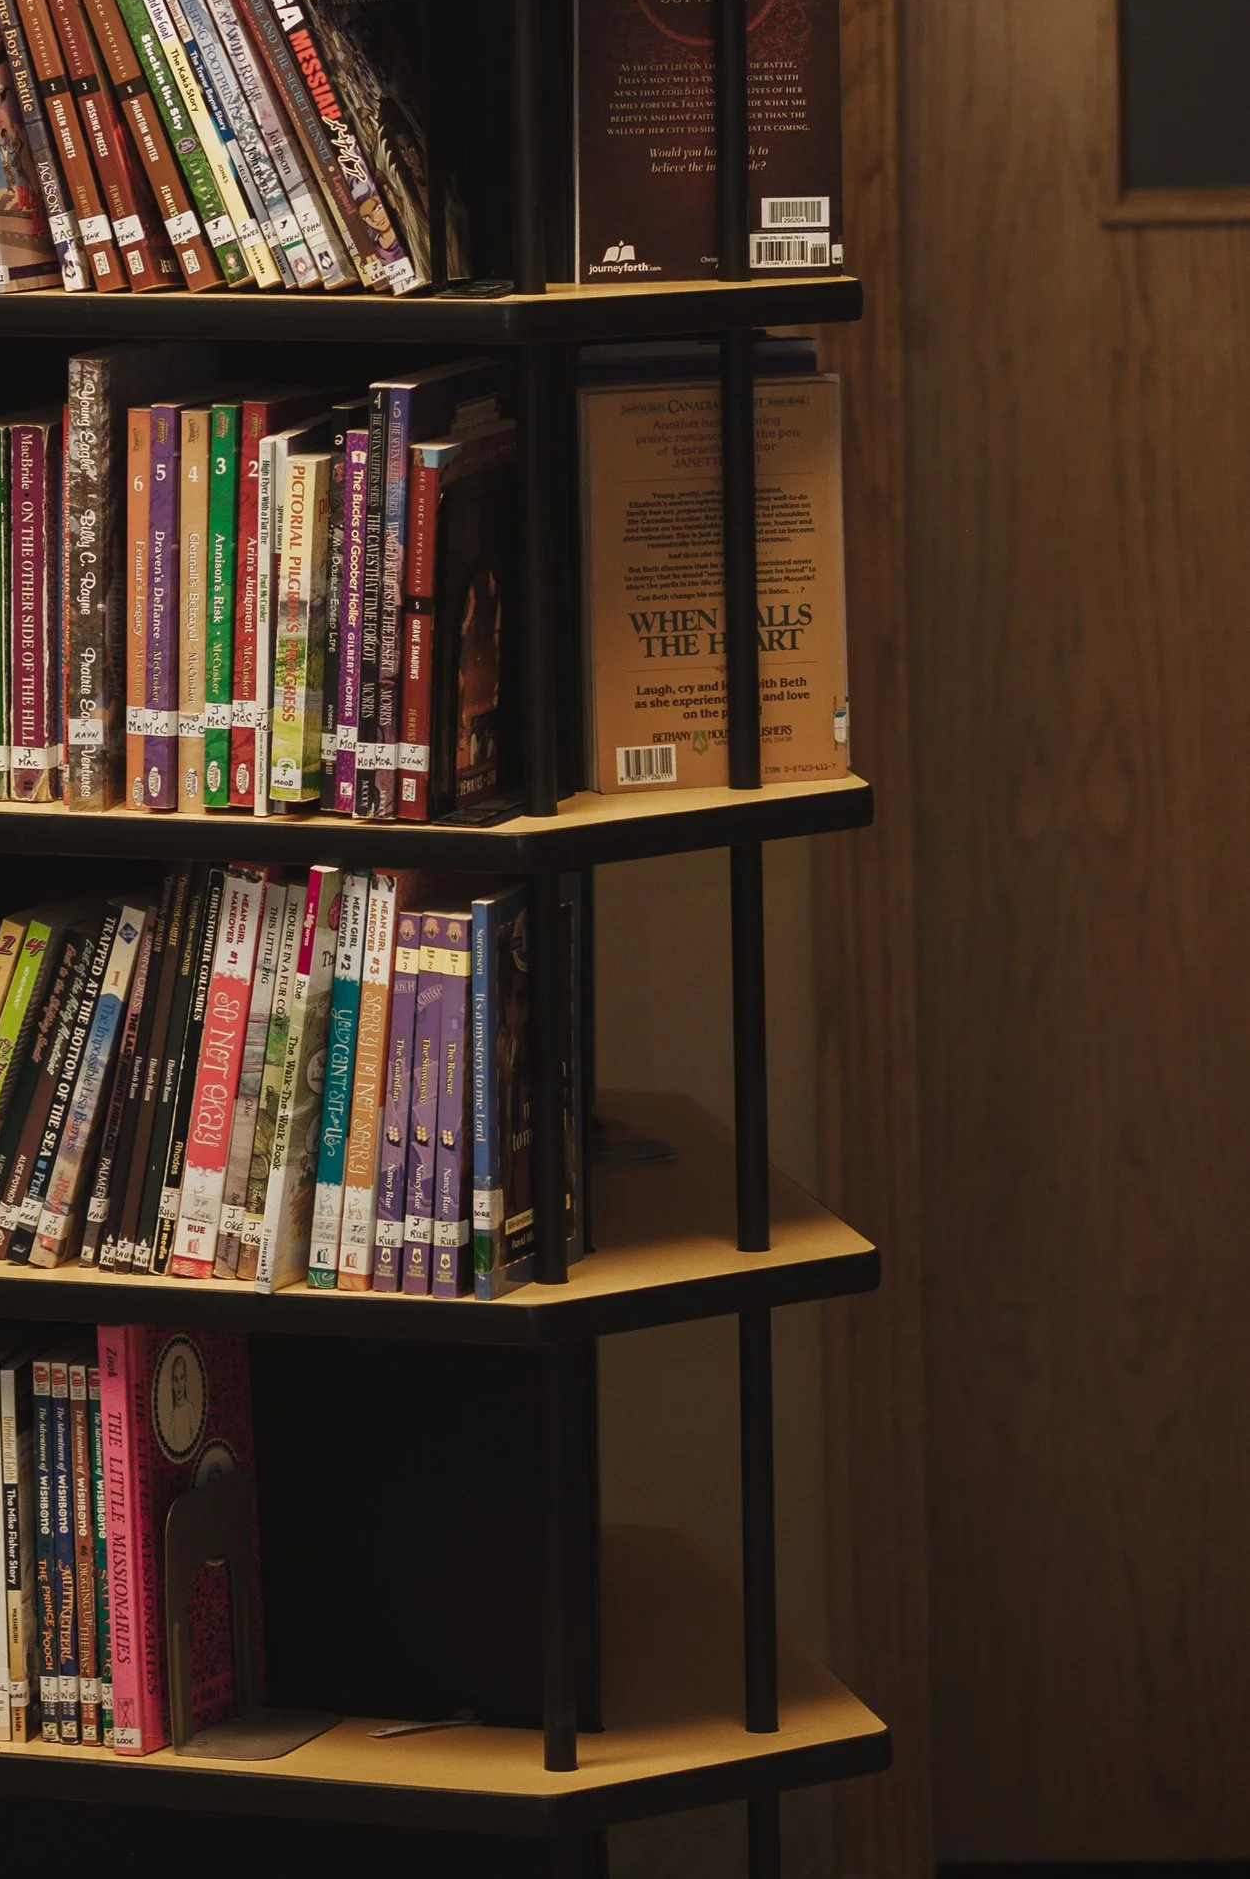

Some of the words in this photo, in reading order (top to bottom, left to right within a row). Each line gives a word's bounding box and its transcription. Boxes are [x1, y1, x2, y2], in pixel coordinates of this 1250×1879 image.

[5, 29, 22, 68] Boy's
[15, 72, 34, 113] Battle
[141, 34, 160, 67] Stuck
[167, 101, 184, 131] Sky
[288, 29, 342, 121] MESSIAH
[185, 88, 200, 112] Story
[52, 99, 66, 127] STOLEN
[61, 128, 77, 159] SECRETS
[84, 100, 100, 131] MISSING
[94, 131, 109, 158] PIECES
[130, 99, 148, 135] PHANTOM
[143, 135, 159, 162] WRITER
[38, 161, 62, 213] JACKSON
[289, 465, 306, 550] PICTORIAL
[351, 494, 362, 528] Bucks
[153, 531, 165, 583] Draven's
[214, 533, 226, 592] Annison's
[152, 588, 164, 639] Defiance
[214, 596, 223, 623] Risk
[286, 556, 302, 633] PILGRIM'S
[348, 593, 360, 628] Holler
[22, 616, 34, 649] SIDE
[410, 619, 421, 643] GRAVE
[628, 608, 718, 634] WHEN
[639, 634, 700, 658] THE
[211, 642, 222, 694] McCusker
[283, 639, 299, 722] PROGRESS
[410, 645, 420, 680] SHADOWS
[637, 685, 676, 696] Laugh,
[678, 685, 695, 694] cry
[698, 683, 718, 692] and
[780, 678, 806, 688] Beth
[653, 731, 692, 743] BETHANY
[203, 886, 220, 963] CHRISTOPHER
[225, 891, 239, 944] MAKEOVER
[241, 894, 250, 918] MEAN
[91, 916, 117, 976] TRAPPED
[236, 921, 245, 945] GIRL
[194, 964, 209, 1021] COLUMBUS
[40, 1130, 56, 1158] SEA
[171, 1141, 184, 1175] Rhodes
[273, 1143, 285, 1171] Book
[94, 1157, 111, 1197] PALMER
[379, 1236, 398, 1245] RUE
[106, 1347, 118, 1378] Zook
[110, 1458, 125, 1523] LITTLE
[111, 1532, 131, 1664] MISSIONARIES
